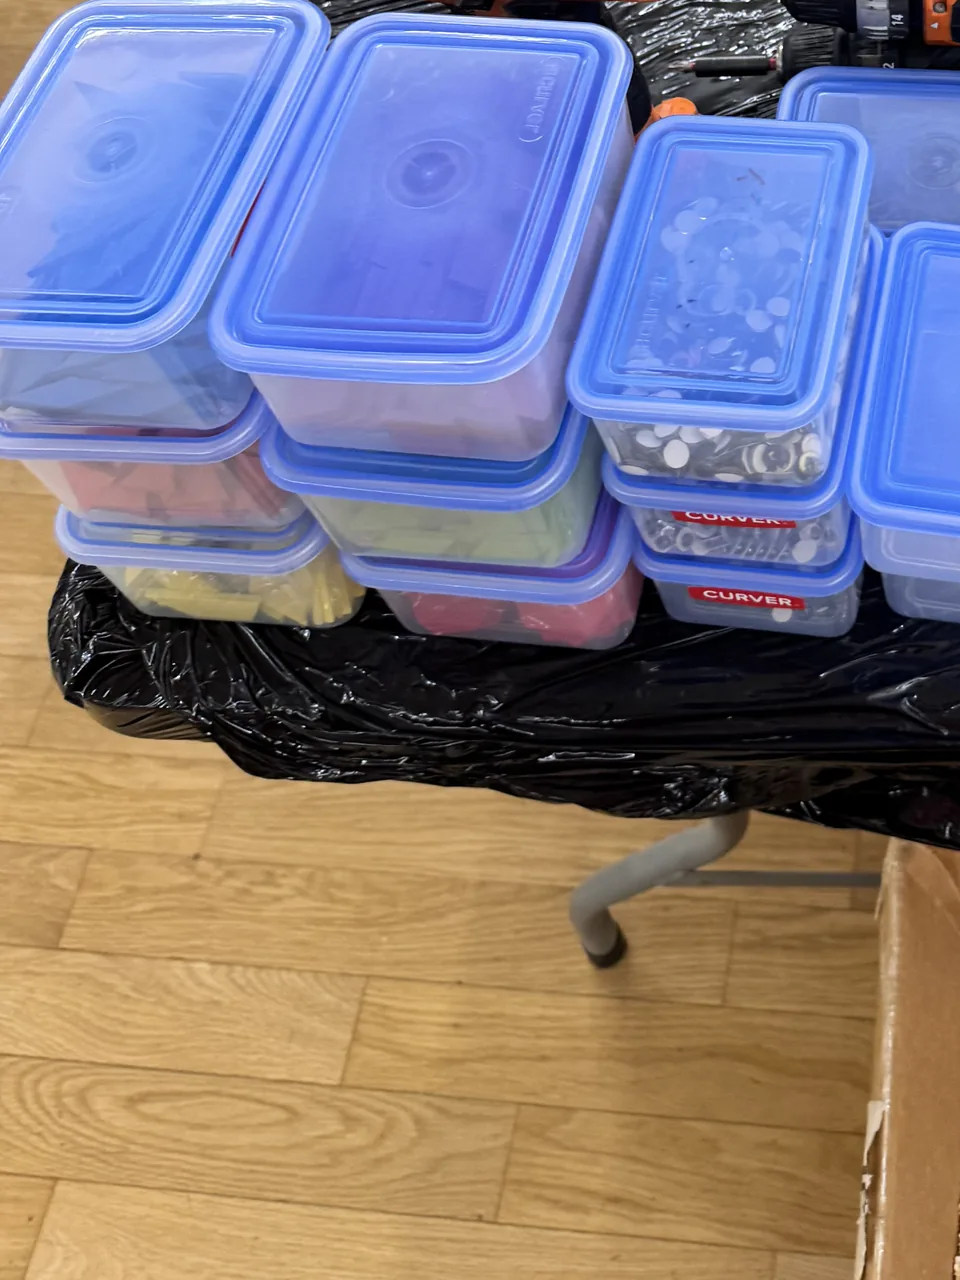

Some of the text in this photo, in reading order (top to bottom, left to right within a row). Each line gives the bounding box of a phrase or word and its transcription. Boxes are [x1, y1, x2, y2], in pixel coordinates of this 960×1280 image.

[891, 14, 904, 26] 14
[685, 511, 782, 525] CURVER
[703, 589, 793, 607] CURVER
